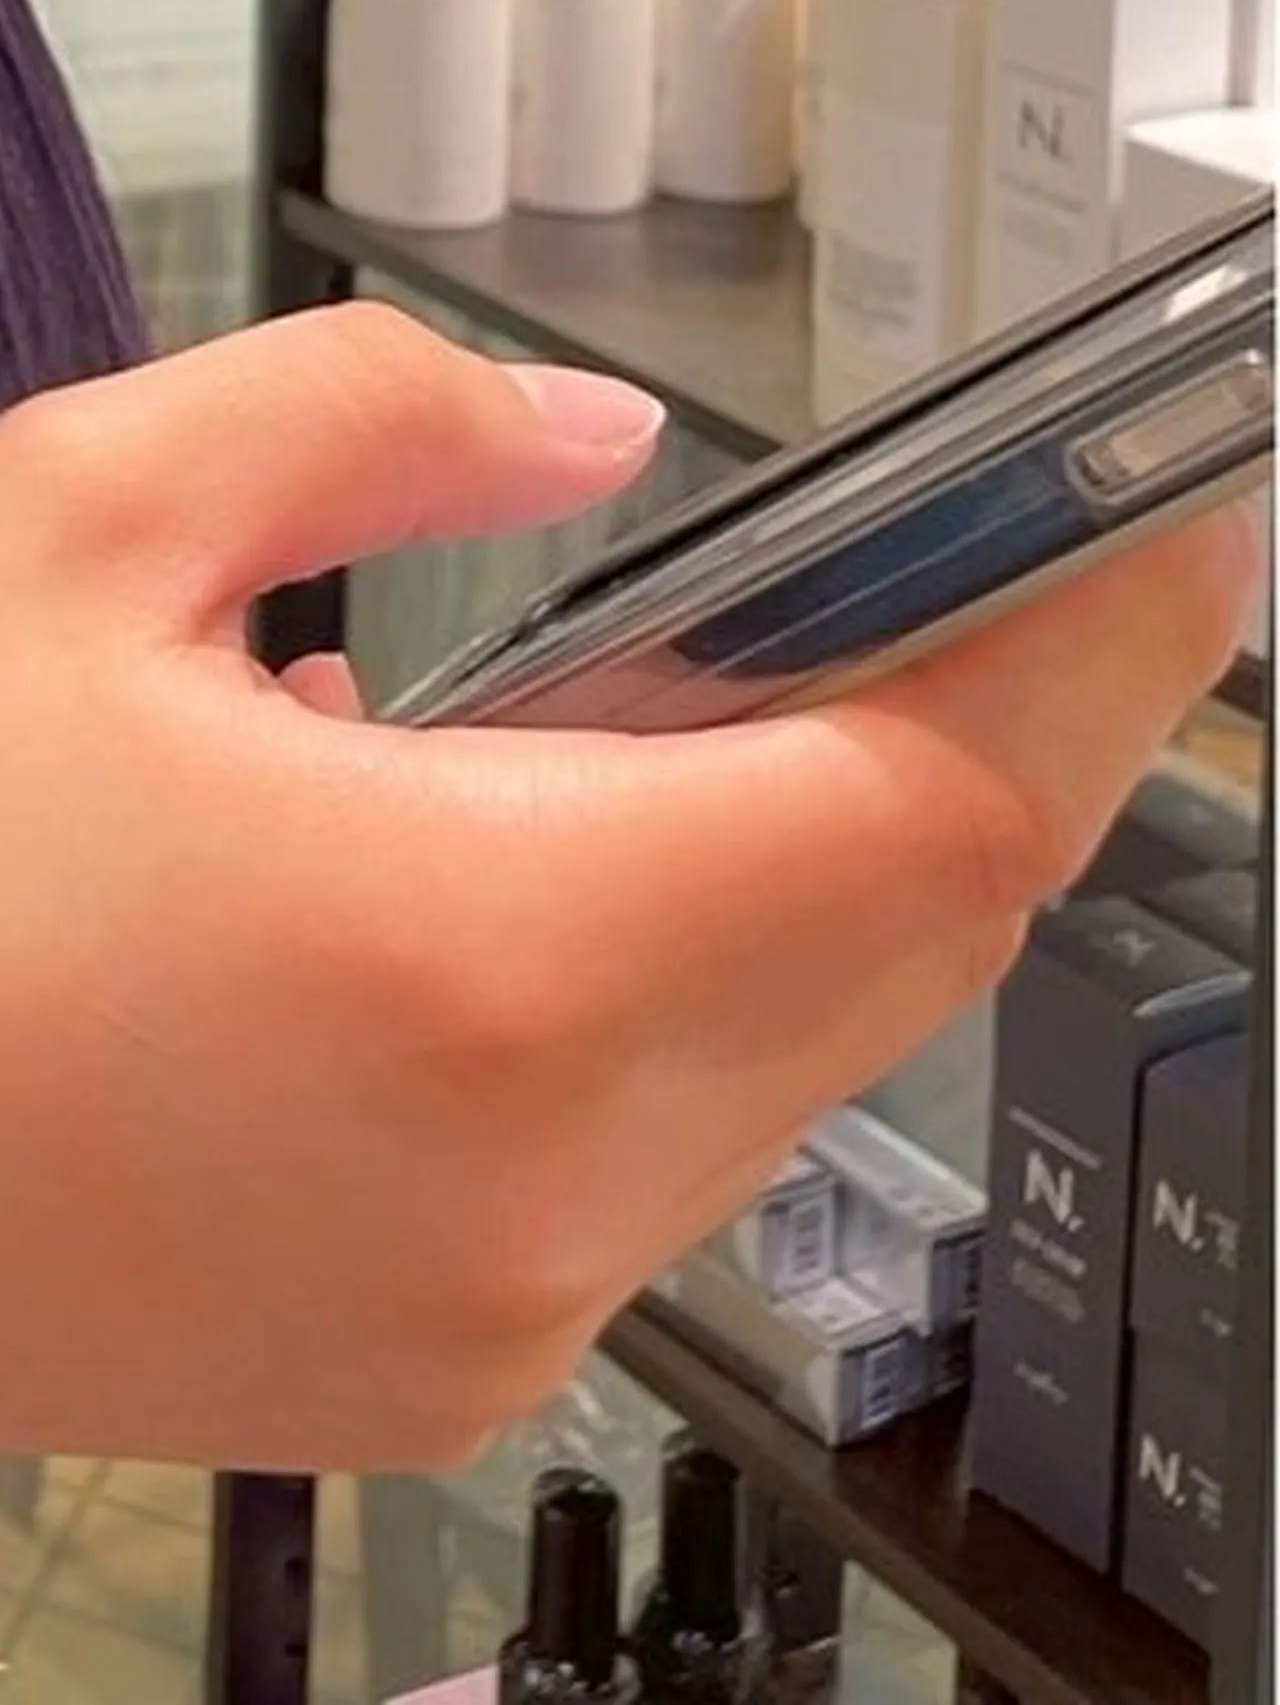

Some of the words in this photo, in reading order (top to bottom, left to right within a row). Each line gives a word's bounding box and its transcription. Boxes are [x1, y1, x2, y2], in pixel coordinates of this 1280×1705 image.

[1023, 1147, 1085, 1232] N.
[1152, 1179, 1204, 1252] N.
[1139, 1433, 1186, 1507] N.
